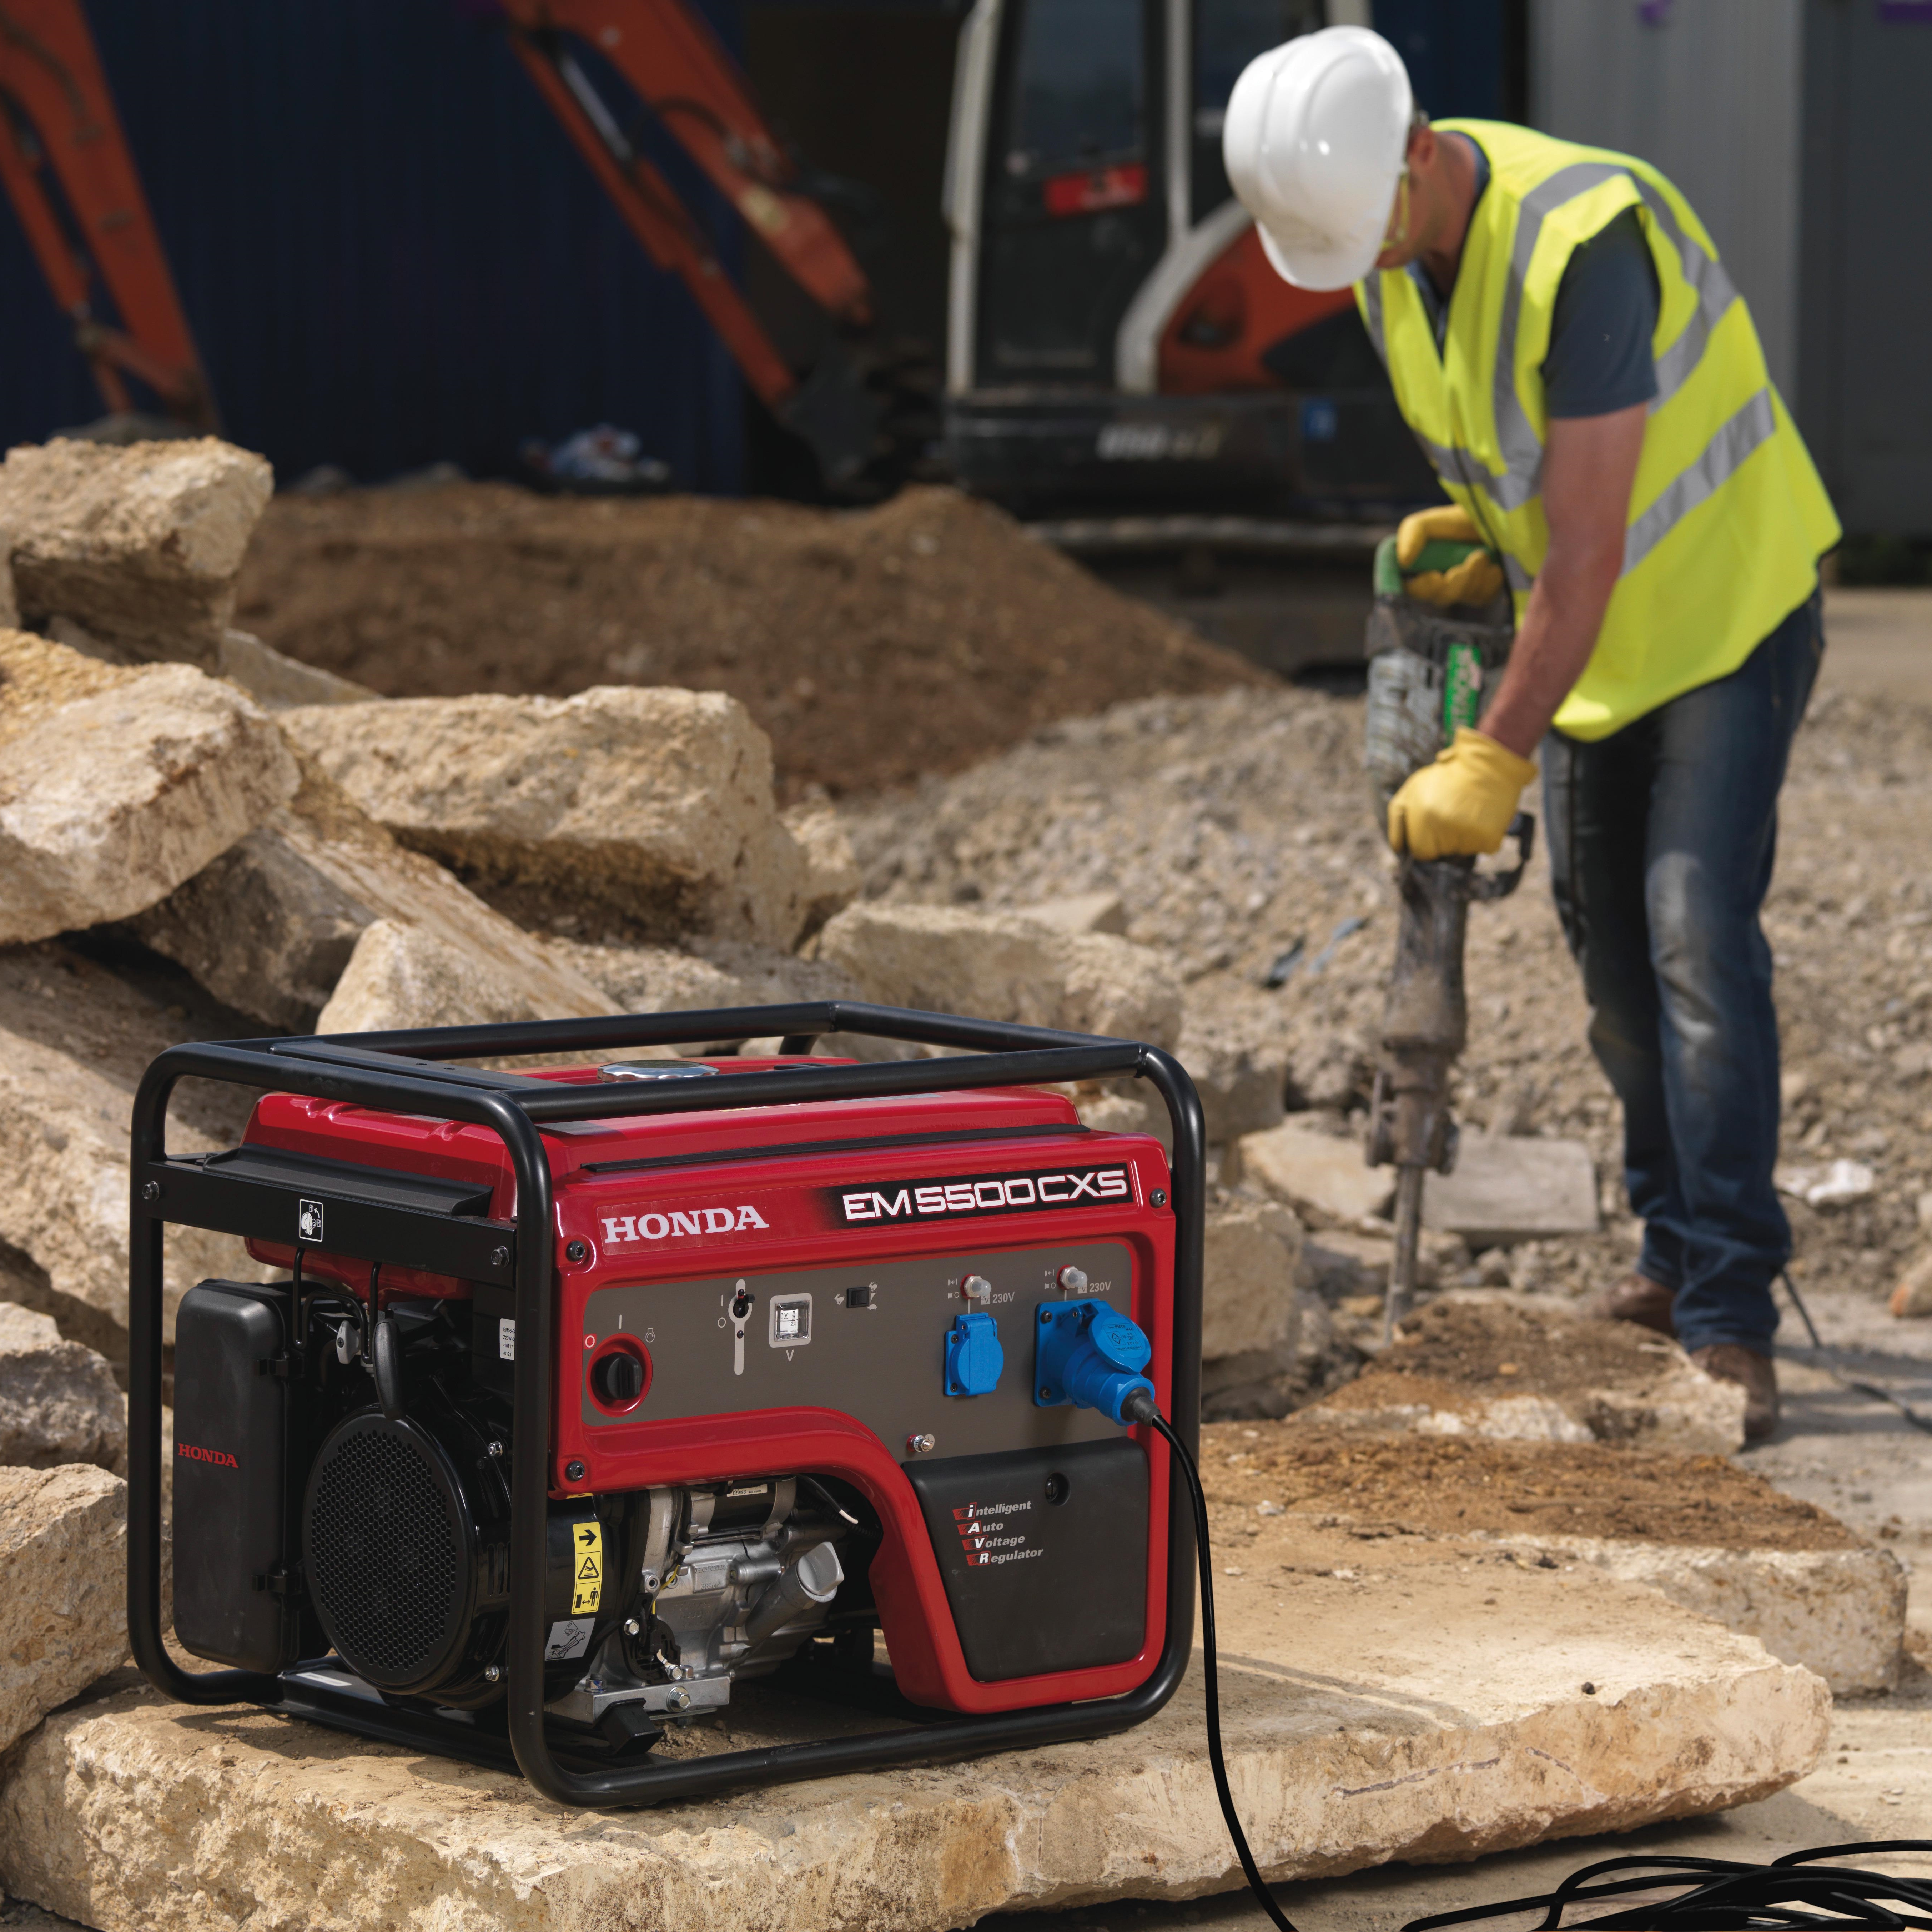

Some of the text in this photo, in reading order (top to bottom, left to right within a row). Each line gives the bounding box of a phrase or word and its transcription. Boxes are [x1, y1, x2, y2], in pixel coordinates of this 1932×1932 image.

[601, 1205, 770, 1243] HONDA
[1089, 1281, 1111, 1292] 230V
[992, 1292, 1015, 1303] 230V
[786, 1349, 795, 1362] V
[178, 1443, 239, 1468] HONDA
[968, 1500, 1032, 1518] intelligent
[967, 1522, 1004, 1534] Auto
[975, 1536, 1025, 1549] Voltage
[979, 1549, 1043, 1564] Regulator
